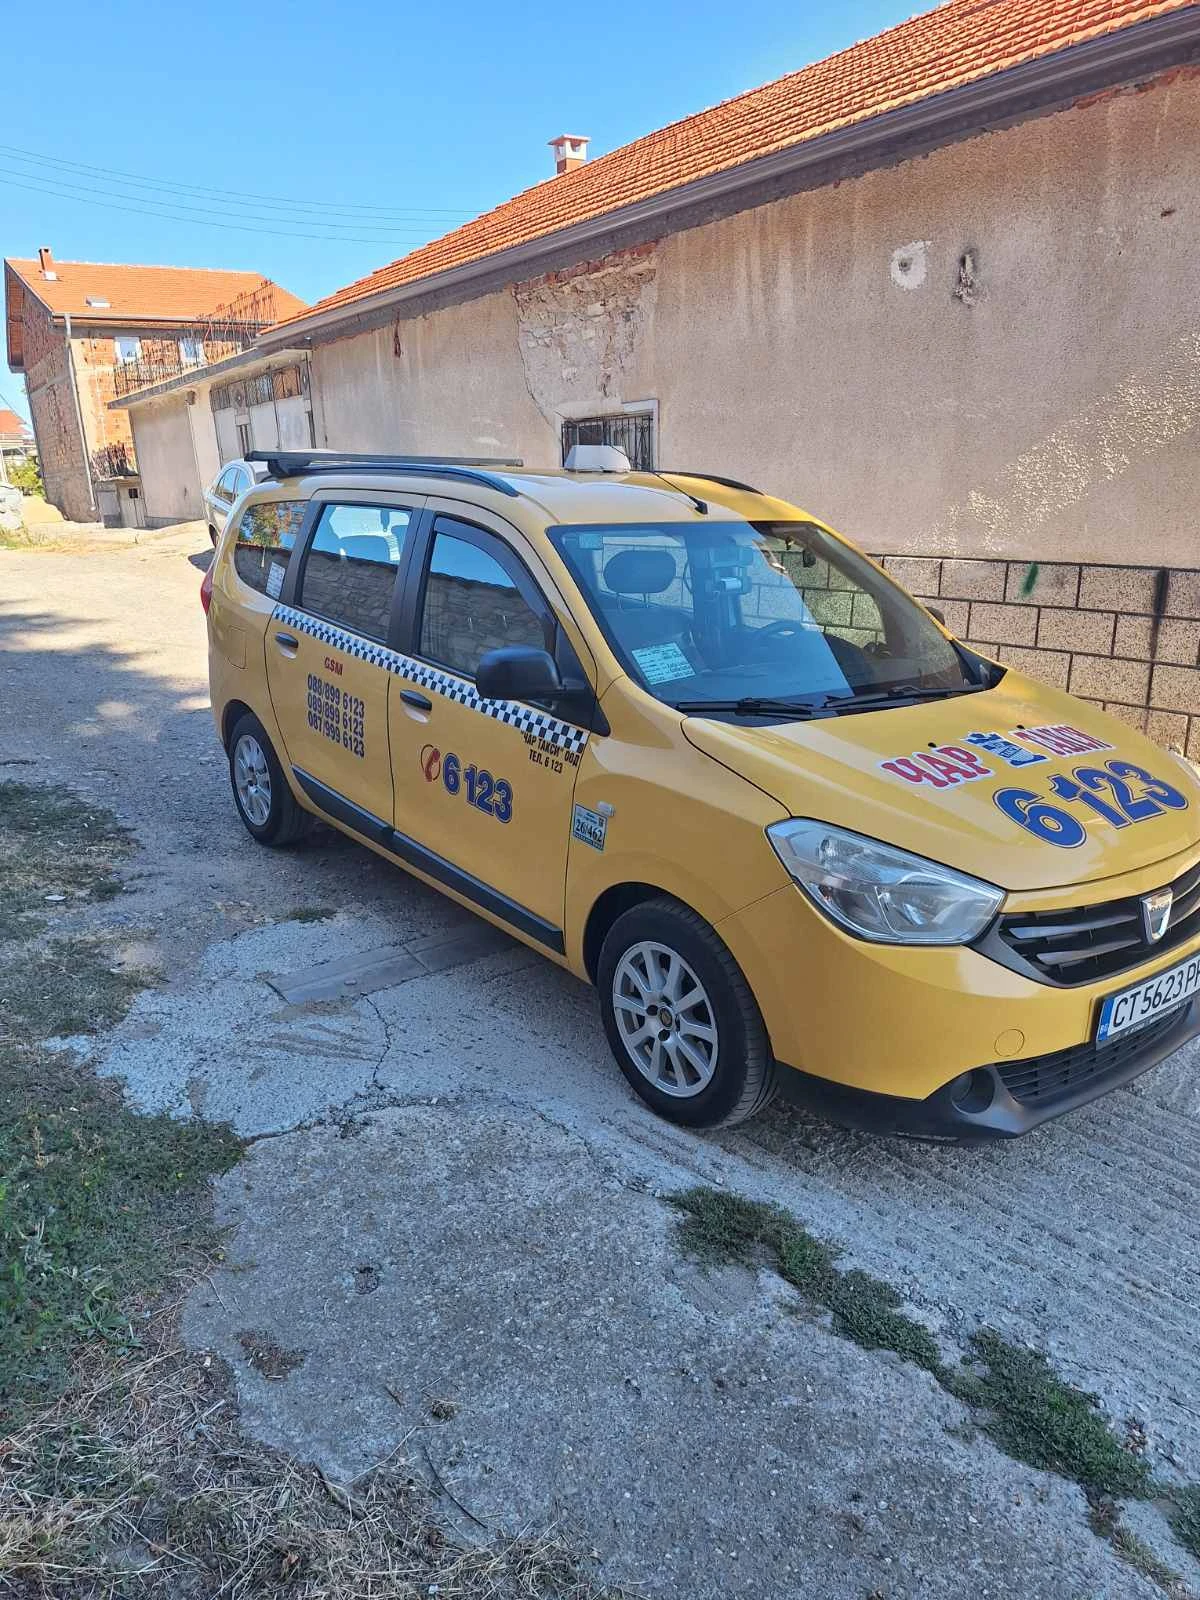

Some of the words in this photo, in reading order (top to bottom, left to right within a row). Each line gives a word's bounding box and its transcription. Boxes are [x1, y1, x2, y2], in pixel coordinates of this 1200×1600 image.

[324, 656, 344, 676] GSM
[307, 673, 340, 706] 088/899
[342, 692, 365, 719] 6123
[307, 692, 340, 724] 089/899
[342, 711, 365, 739] 6123
[307, 711, 340, 743] 087/999
[342, 730, 365, 758] 6123
[529, 749, 543, 765] ТЕЛ.
[551, 760, 563, 774] 123
[564, 750, 580, 767] ООД
[881, 746, 991, 788] ЧАР
